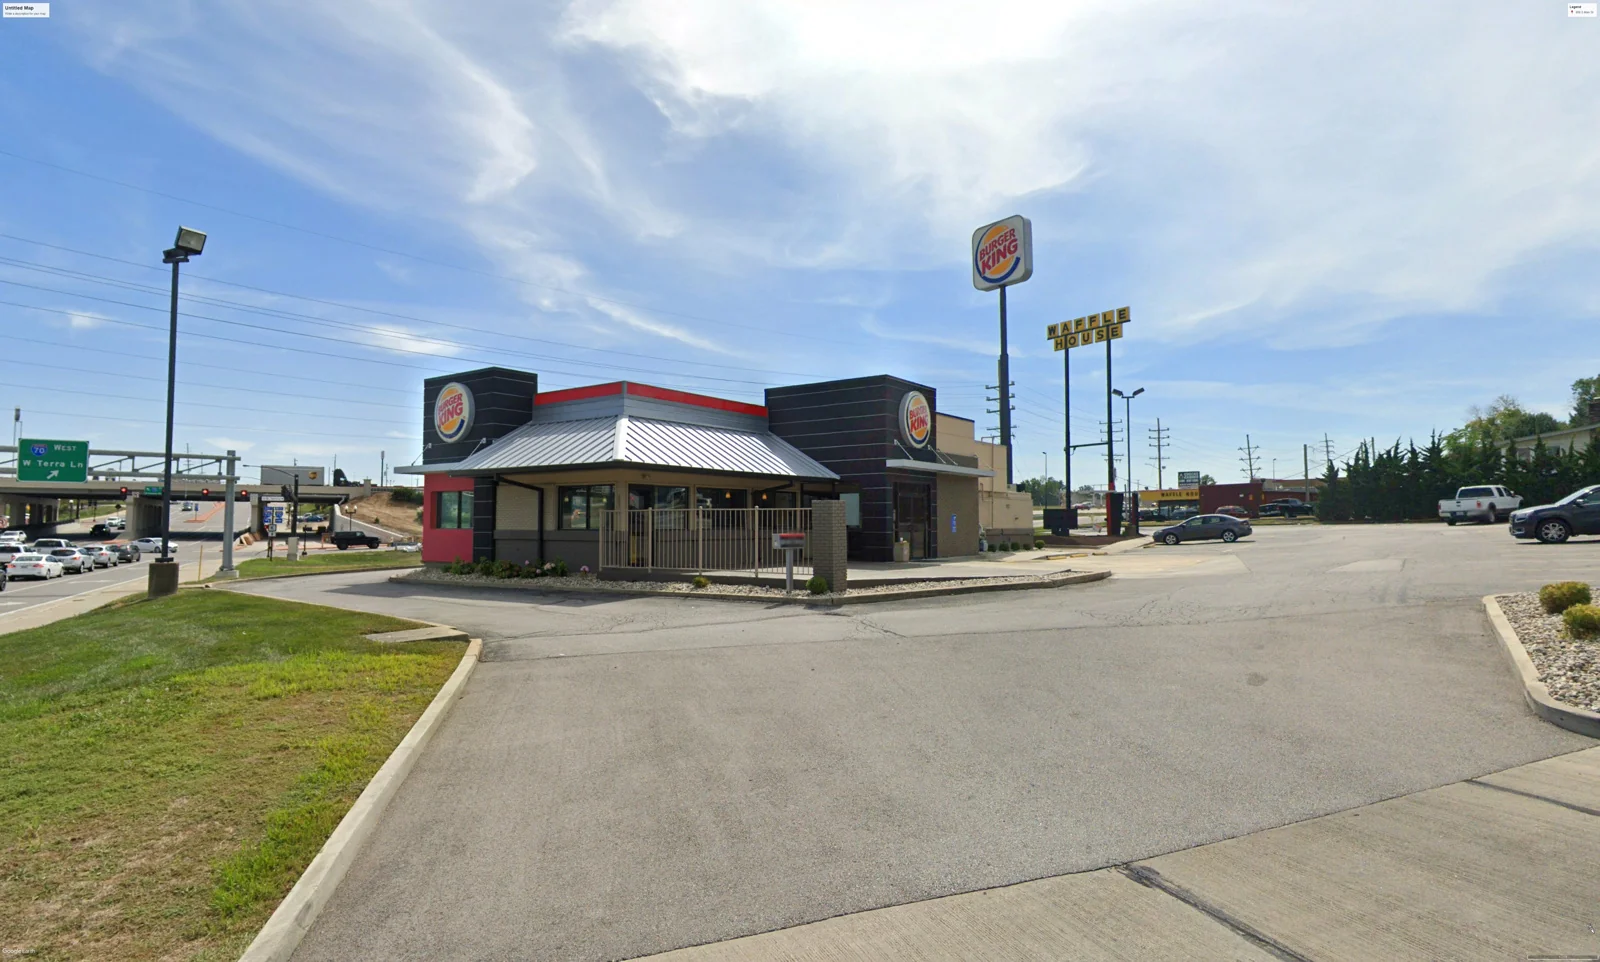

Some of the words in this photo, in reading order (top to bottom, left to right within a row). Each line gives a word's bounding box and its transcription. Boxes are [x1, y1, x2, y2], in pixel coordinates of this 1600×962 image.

[979, 228, 1016, 262] BURGER
[981, 238, 1018, 276] KING
[1048, 309, 1127, 336] WAFFLE
[1055, 326, 1119, 349] HOUSE
[437, 401, 463, 429] KING
[438, 393, 463, 413] BURGER
[37, 460, 65, 468] Terra
